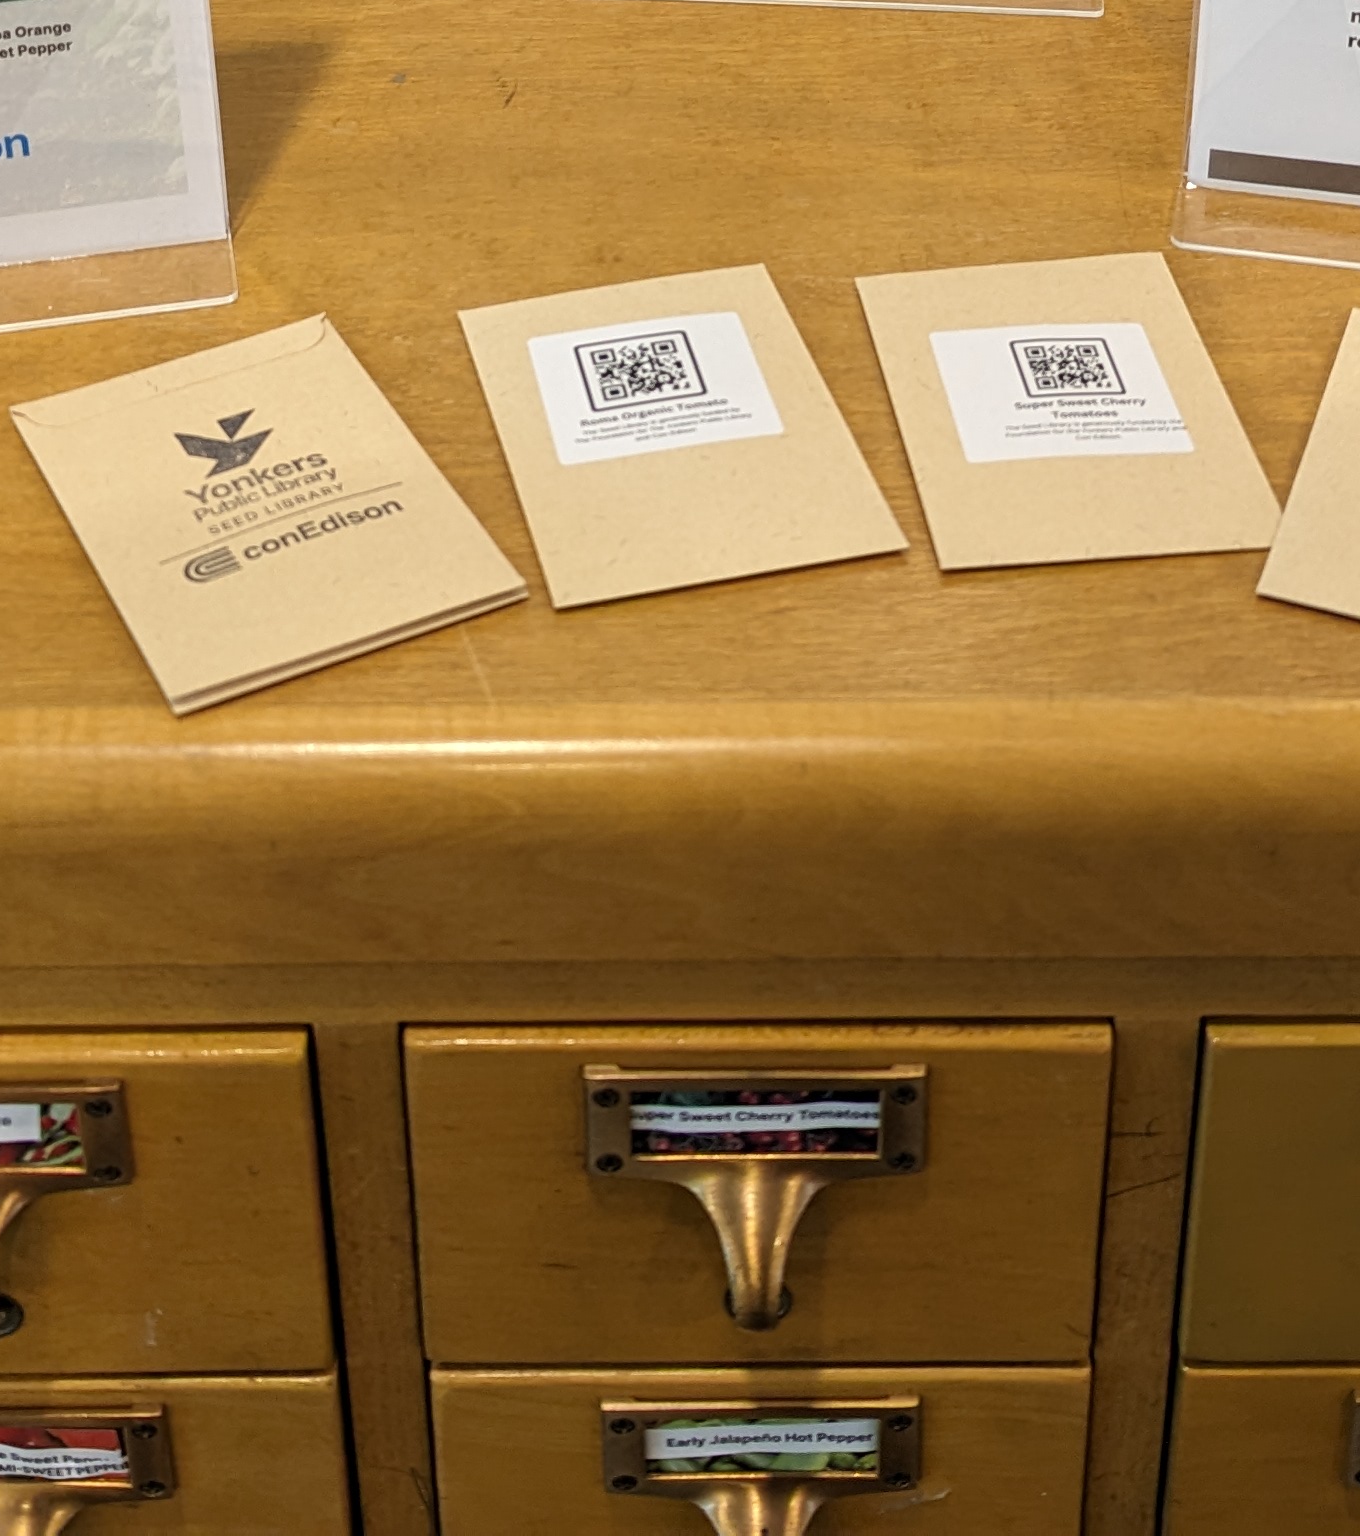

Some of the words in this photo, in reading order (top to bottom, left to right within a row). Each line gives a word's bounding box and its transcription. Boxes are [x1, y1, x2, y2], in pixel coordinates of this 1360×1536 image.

[14, 23, 72, 39] Orange
[17, 41, 73, 57] Pepper
[579, 415, 620, 427] Roma
[620, 405, 674, 421] Organic
[676, 398, 729, 412] Tomato
[1014, 400, 1054, 410] Super
[1056, 398, 1098, 407] Sweet
[1100, 397, 1146, 407] Cherry
[1051, 410, 1119, 419] Tomatoes
[185, 453, 329, 506] Yonkers
[193, 491, 262, 523] Public
[260, 467, 337, 498] Library
[208, 510, 259, 535] SEED
[263, 481, 344, 516] LIBRARY
[243, 500, 404, 561] conEdison
[634, 1110, 674, 1121] uper
